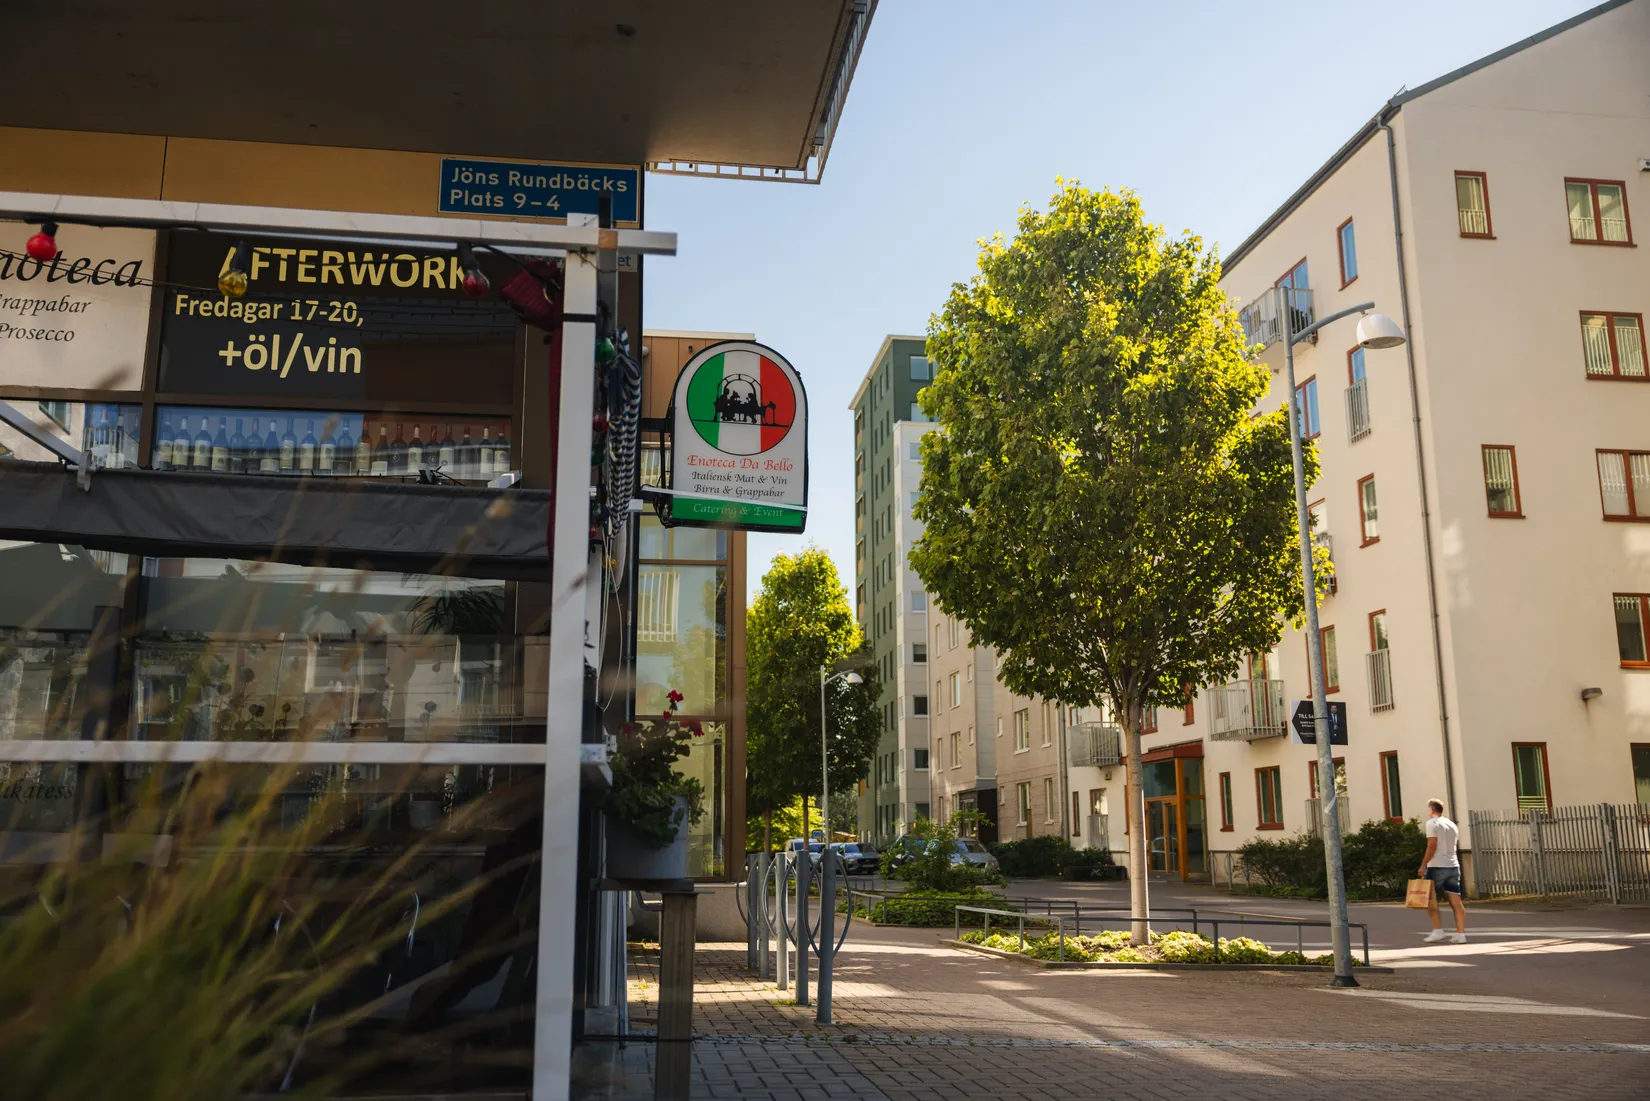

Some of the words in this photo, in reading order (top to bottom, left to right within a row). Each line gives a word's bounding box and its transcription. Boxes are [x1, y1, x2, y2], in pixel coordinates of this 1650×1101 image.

[451, 167, 500, 186] Jöns
[508, 170, 628, 193] Rundbäcks
[450, 189, 504, 208] Plats
[0, 294, 91, 316] rappabar
[175, 294, 283, 323] Fredagar
[290, 300, 364, 326] 17-20,
[0, 323, 75, 342] Prosecco
[218, 332, 362, 378] +öl/vin
[687, 455, 736, 468] Enoteca
[740, 458, 759, 470] Da
[763, 458, 793, 471] Bello
[691, 470, 732, 482] Italiensk
[735, 473, 754, 483] Mat
[758, 475, 768, 484] &
[770, 475, 787, 485] Vin
[694, 484, 720, 494] Birra
[723, 486, 733, 495] &
[735, 486, 785, 500] Grappabar
[693, 503, 737, 518] Catering
[740, 506, 750, 516] &
[753, 506, 783, 517] Event
